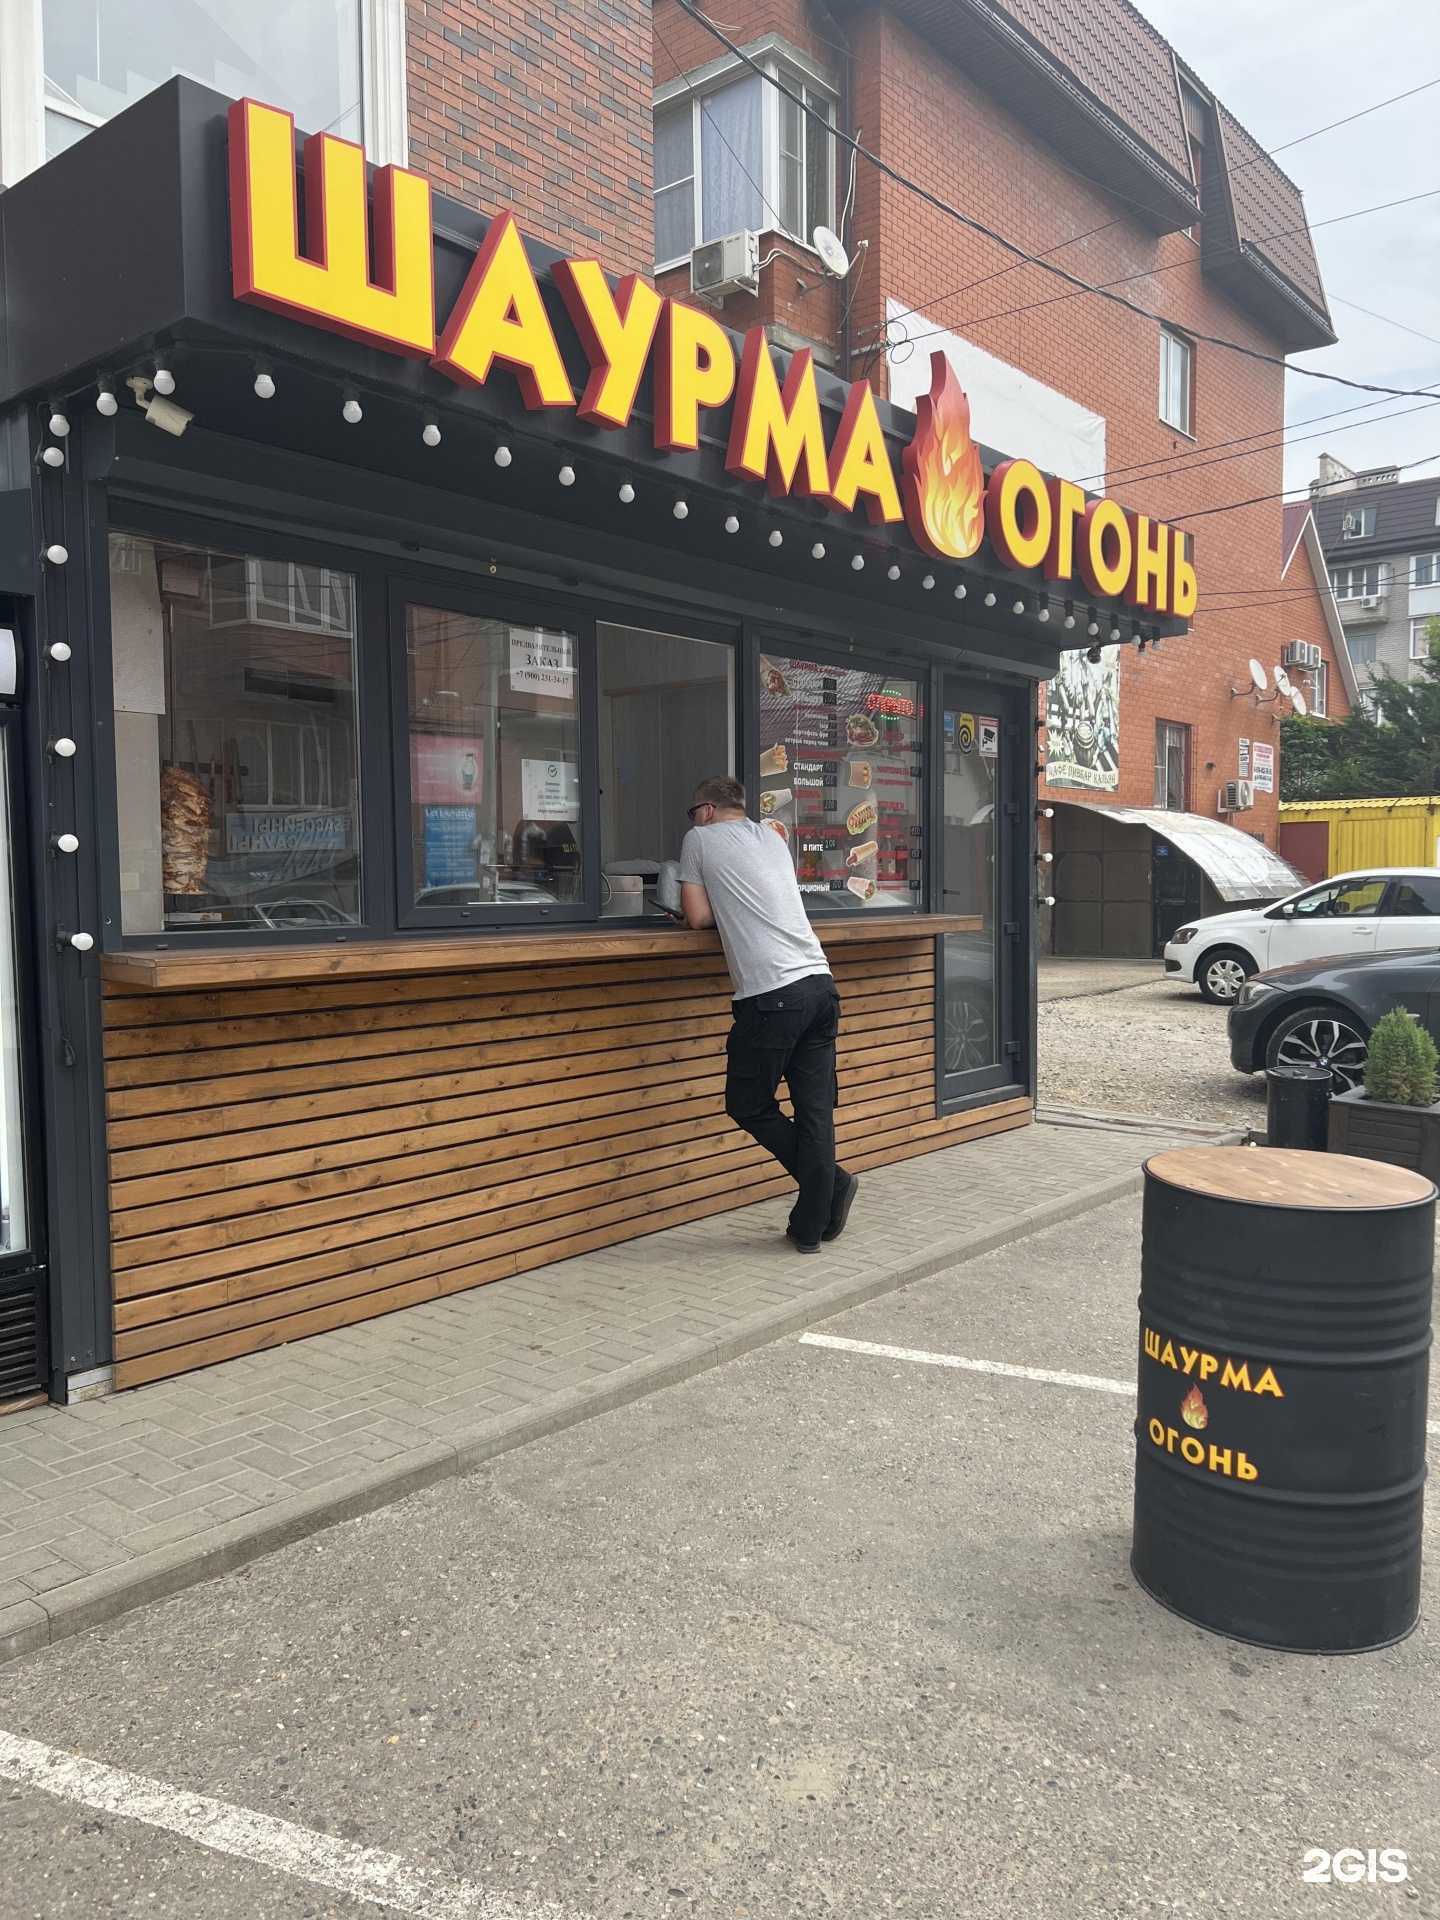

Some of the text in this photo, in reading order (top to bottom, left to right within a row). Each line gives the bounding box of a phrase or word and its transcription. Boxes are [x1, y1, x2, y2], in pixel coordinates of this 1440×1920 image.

[228, 97, 1198, 619] ШАУРМА ОГОНЬ
[527, 655, 559, 668] ЗАКАЗ
[793, 762, 824, 772] СТАНДАРТ
[793, 776, 824, 787] БОЛЬШОЙ
[803, 843, 808, 851] В
[808, 843, 824, 852] ПИТЕ
[1144, 1327, 1284, 1398] ШАУРМА
[1149, 1417, 1259, 1481] ОГОНЬ
